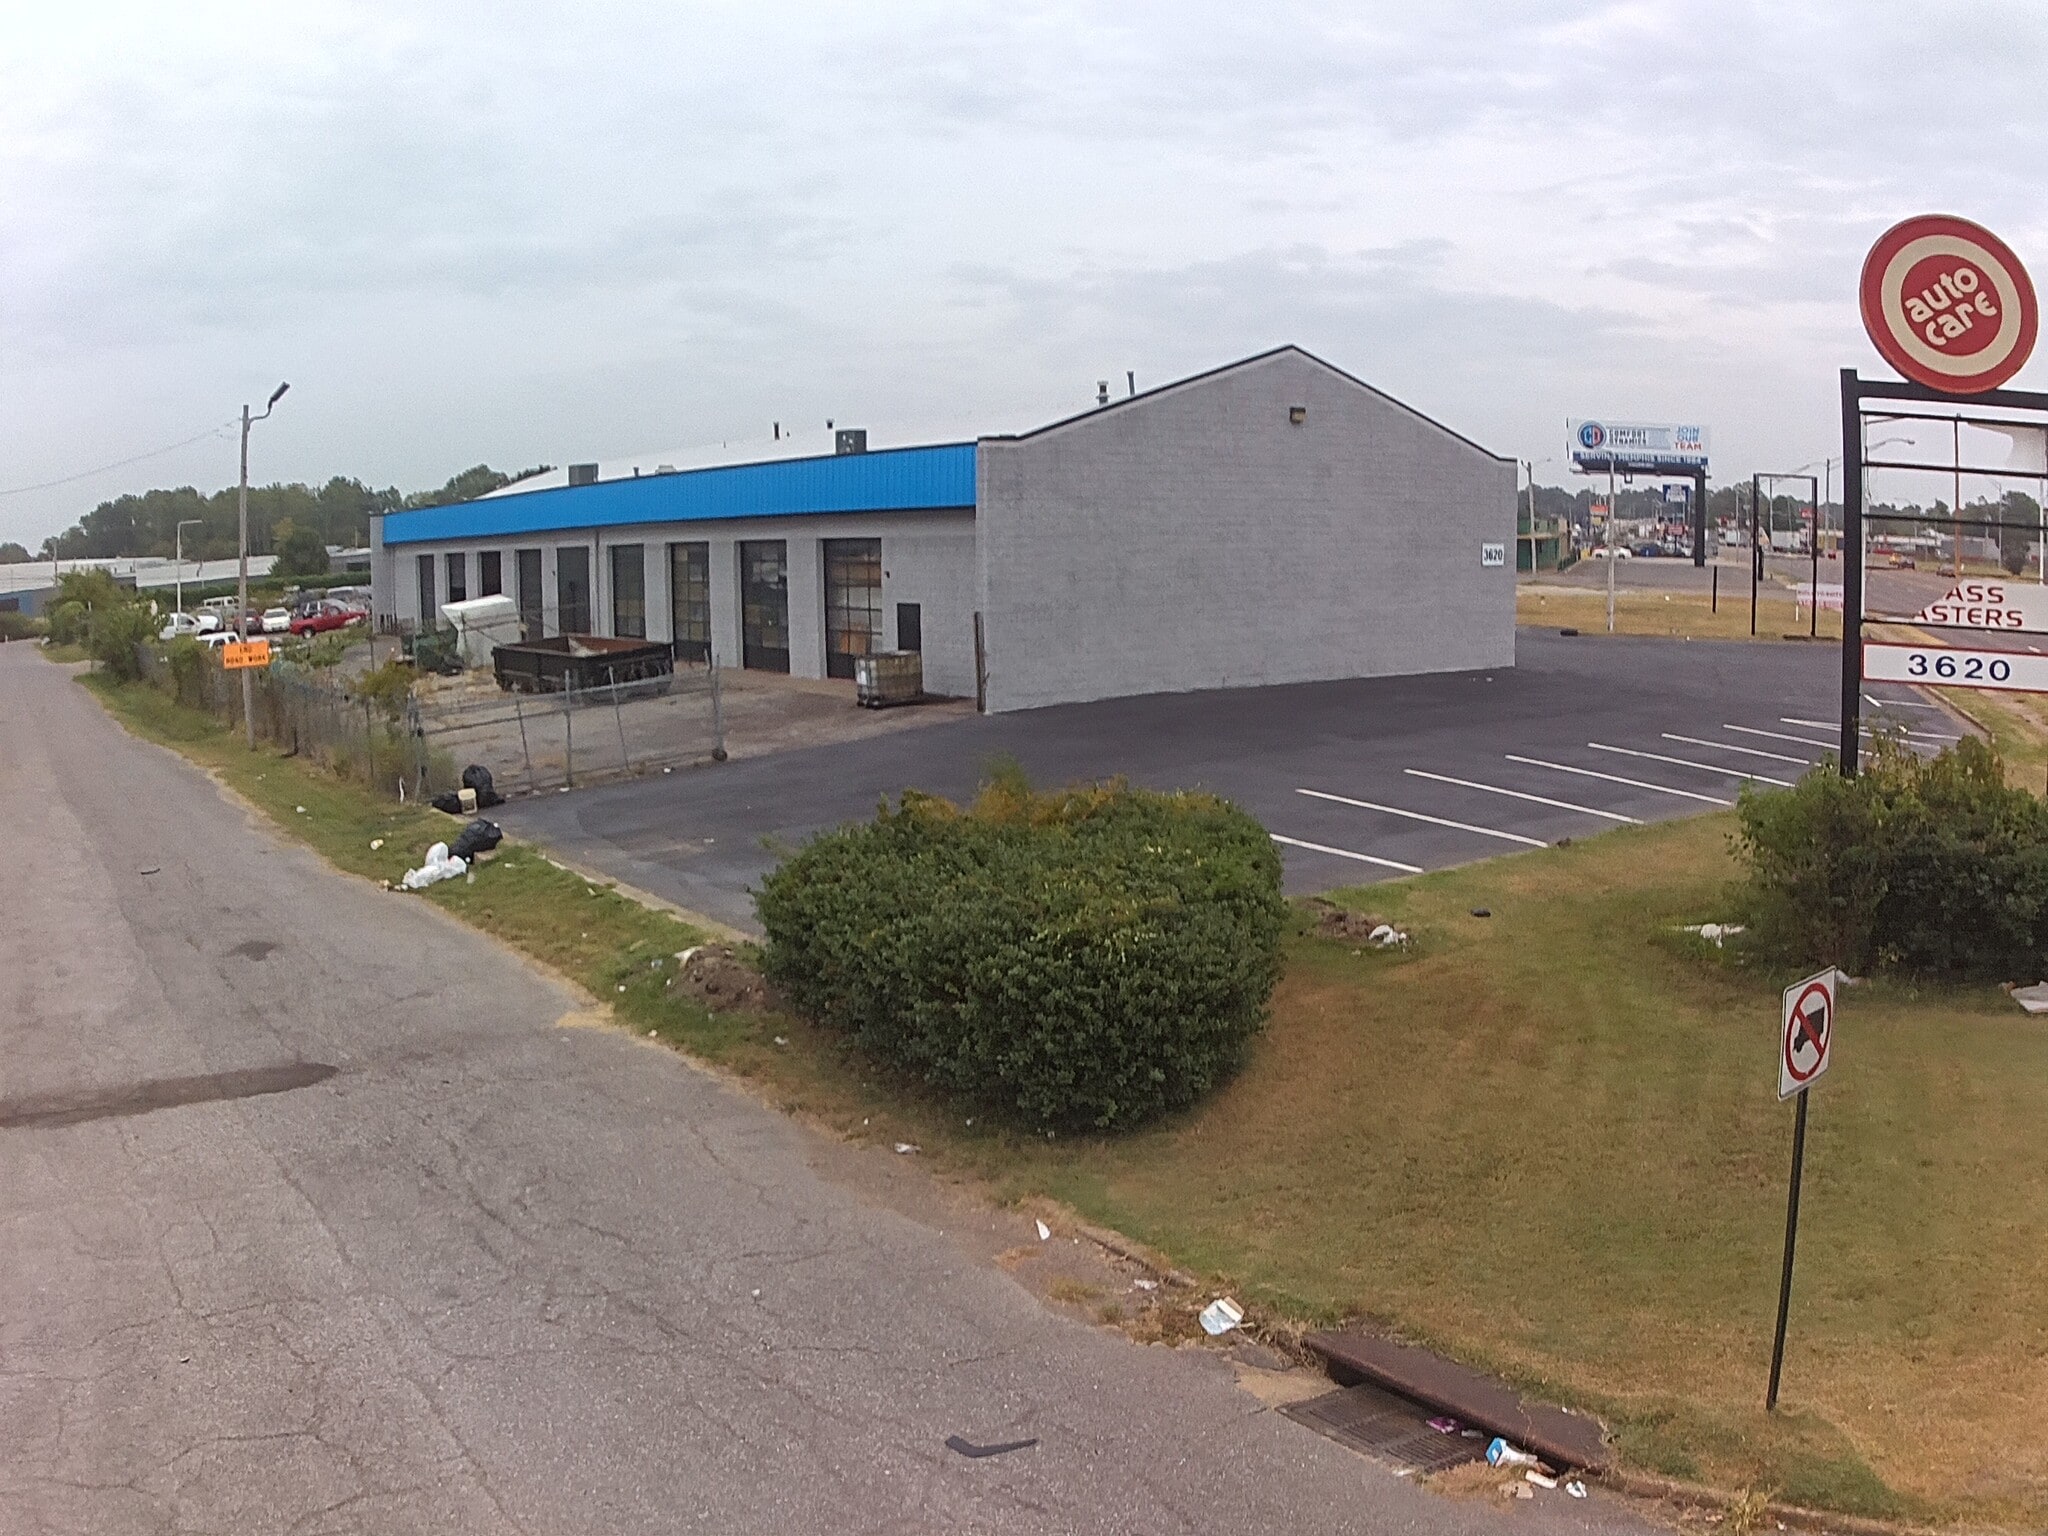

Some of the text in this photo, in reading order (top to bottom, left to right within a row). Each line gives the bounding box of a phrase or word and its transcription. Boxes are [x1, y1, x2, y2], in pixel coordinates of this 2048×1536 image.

[1905, 267, 1979, 323] auto
[1925, 290, 1998, 346] care
[1608, 429, 1646, 438] COMFORT
[1677, 426, 1700, 434] JOIN
[1608, 438, 1647, 446] DYNAMICS
[1674, 441, 1702, 450] TEAM
[1580, 451, 1616, 460] SERVIN
[1483, 548, 1503, 561] 3620
[1946, 584, 2004, 604] ASS
[1907, 653, 2012, 682] 3620
